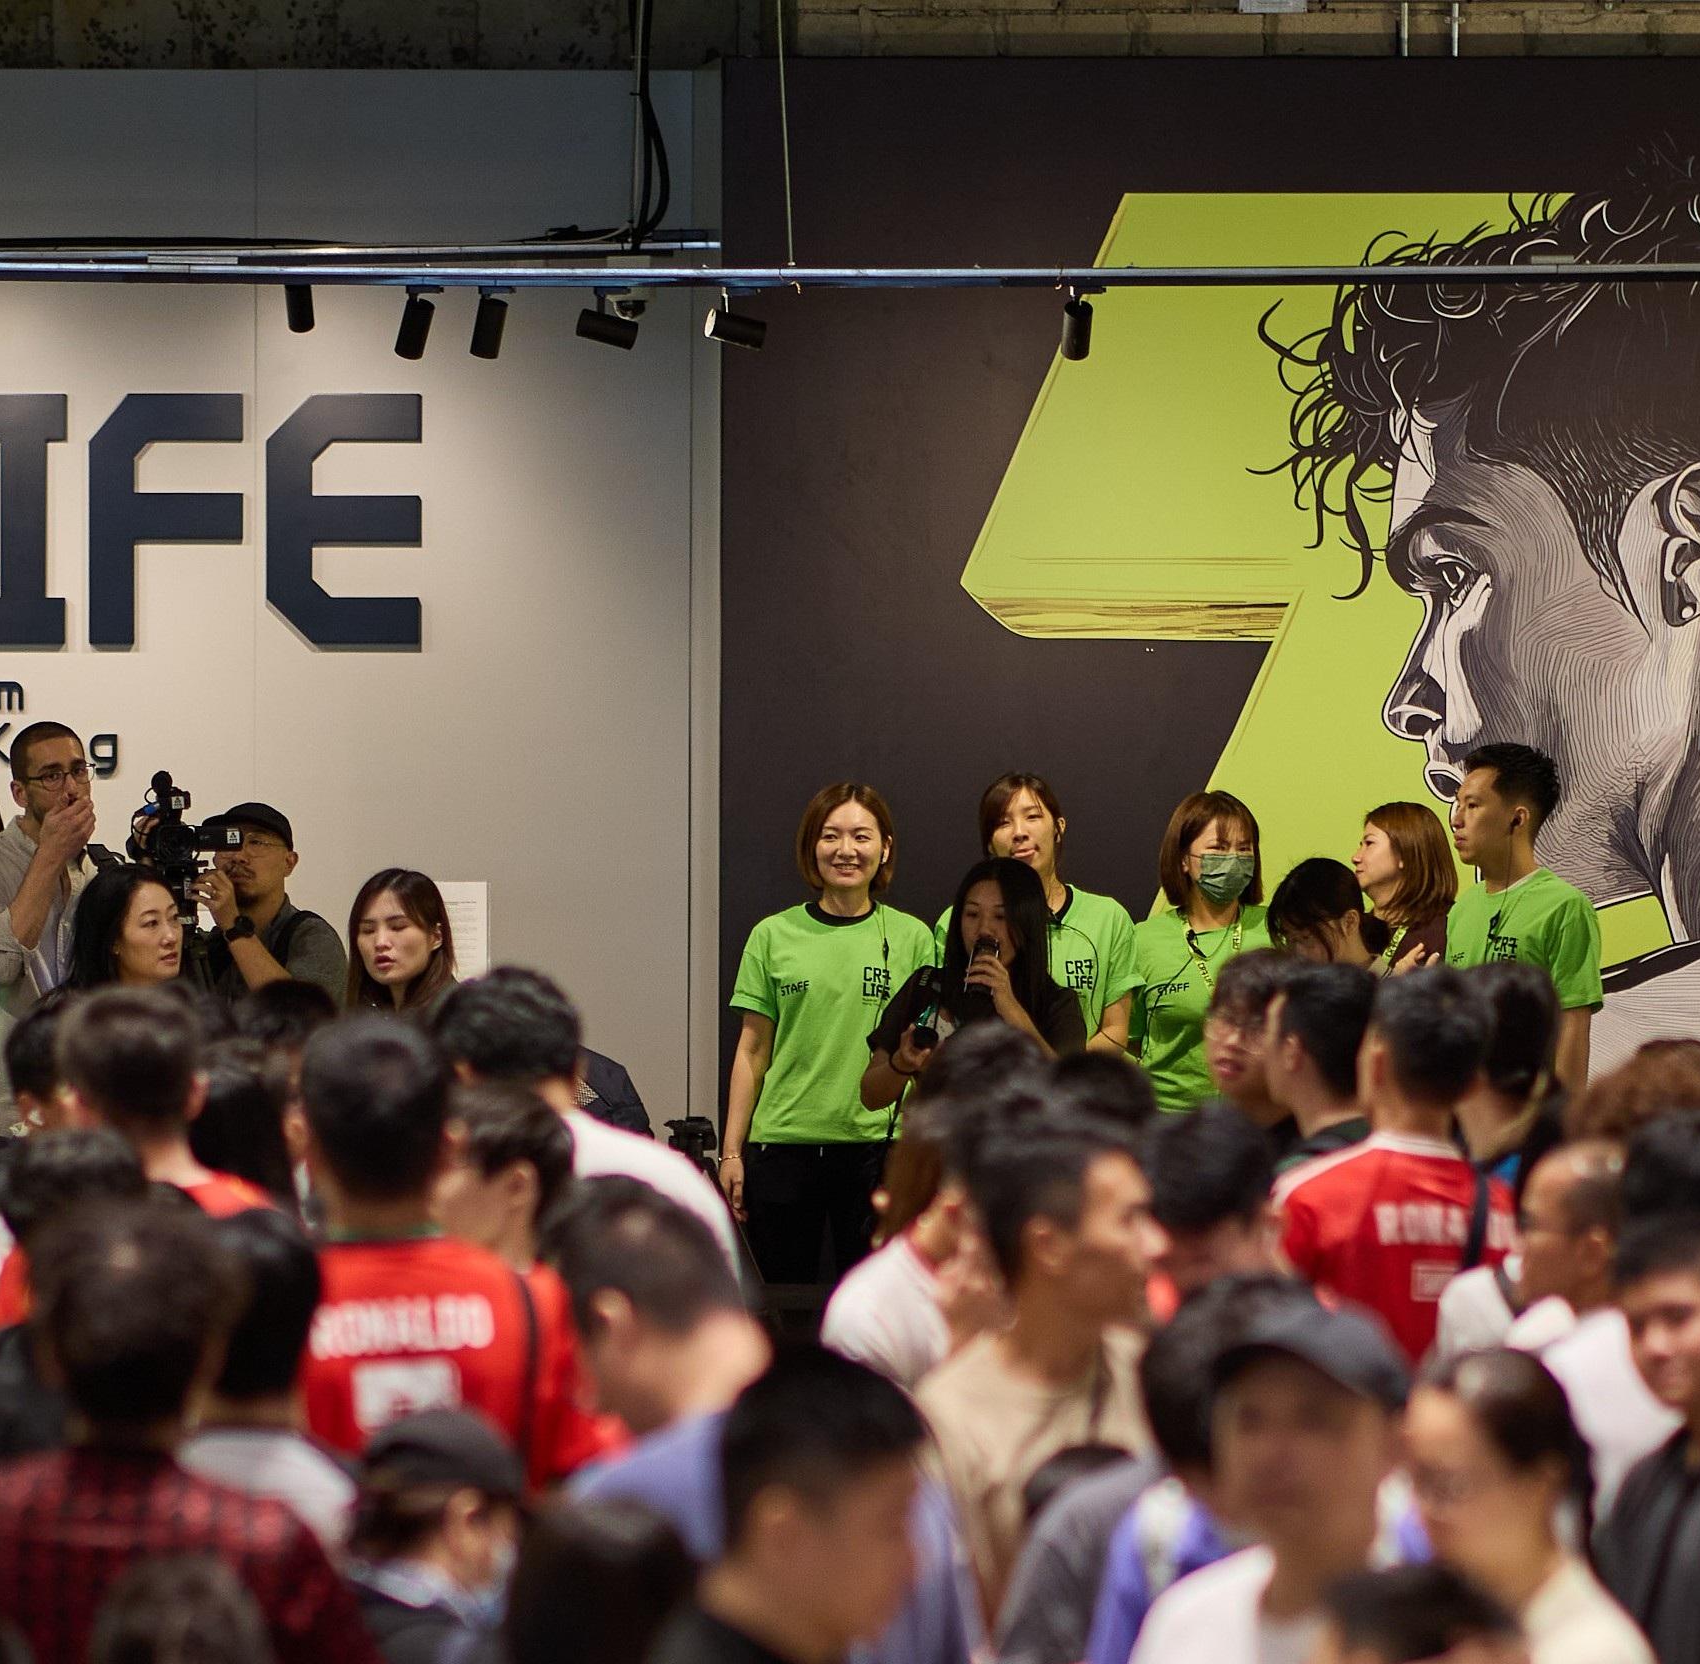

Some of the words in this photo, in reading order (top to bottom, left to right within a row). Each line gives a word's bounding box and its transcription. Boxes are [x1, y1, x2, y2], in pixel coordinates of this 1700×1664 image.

[1065, 959, 1093, 975] CR7
[863, 966, 892, 985] CR7
[1067, 975, 1093, 990] LIFE
[781, 980, 810, 997] STAFF
[1157, 982, 1190, 996] STAFF
